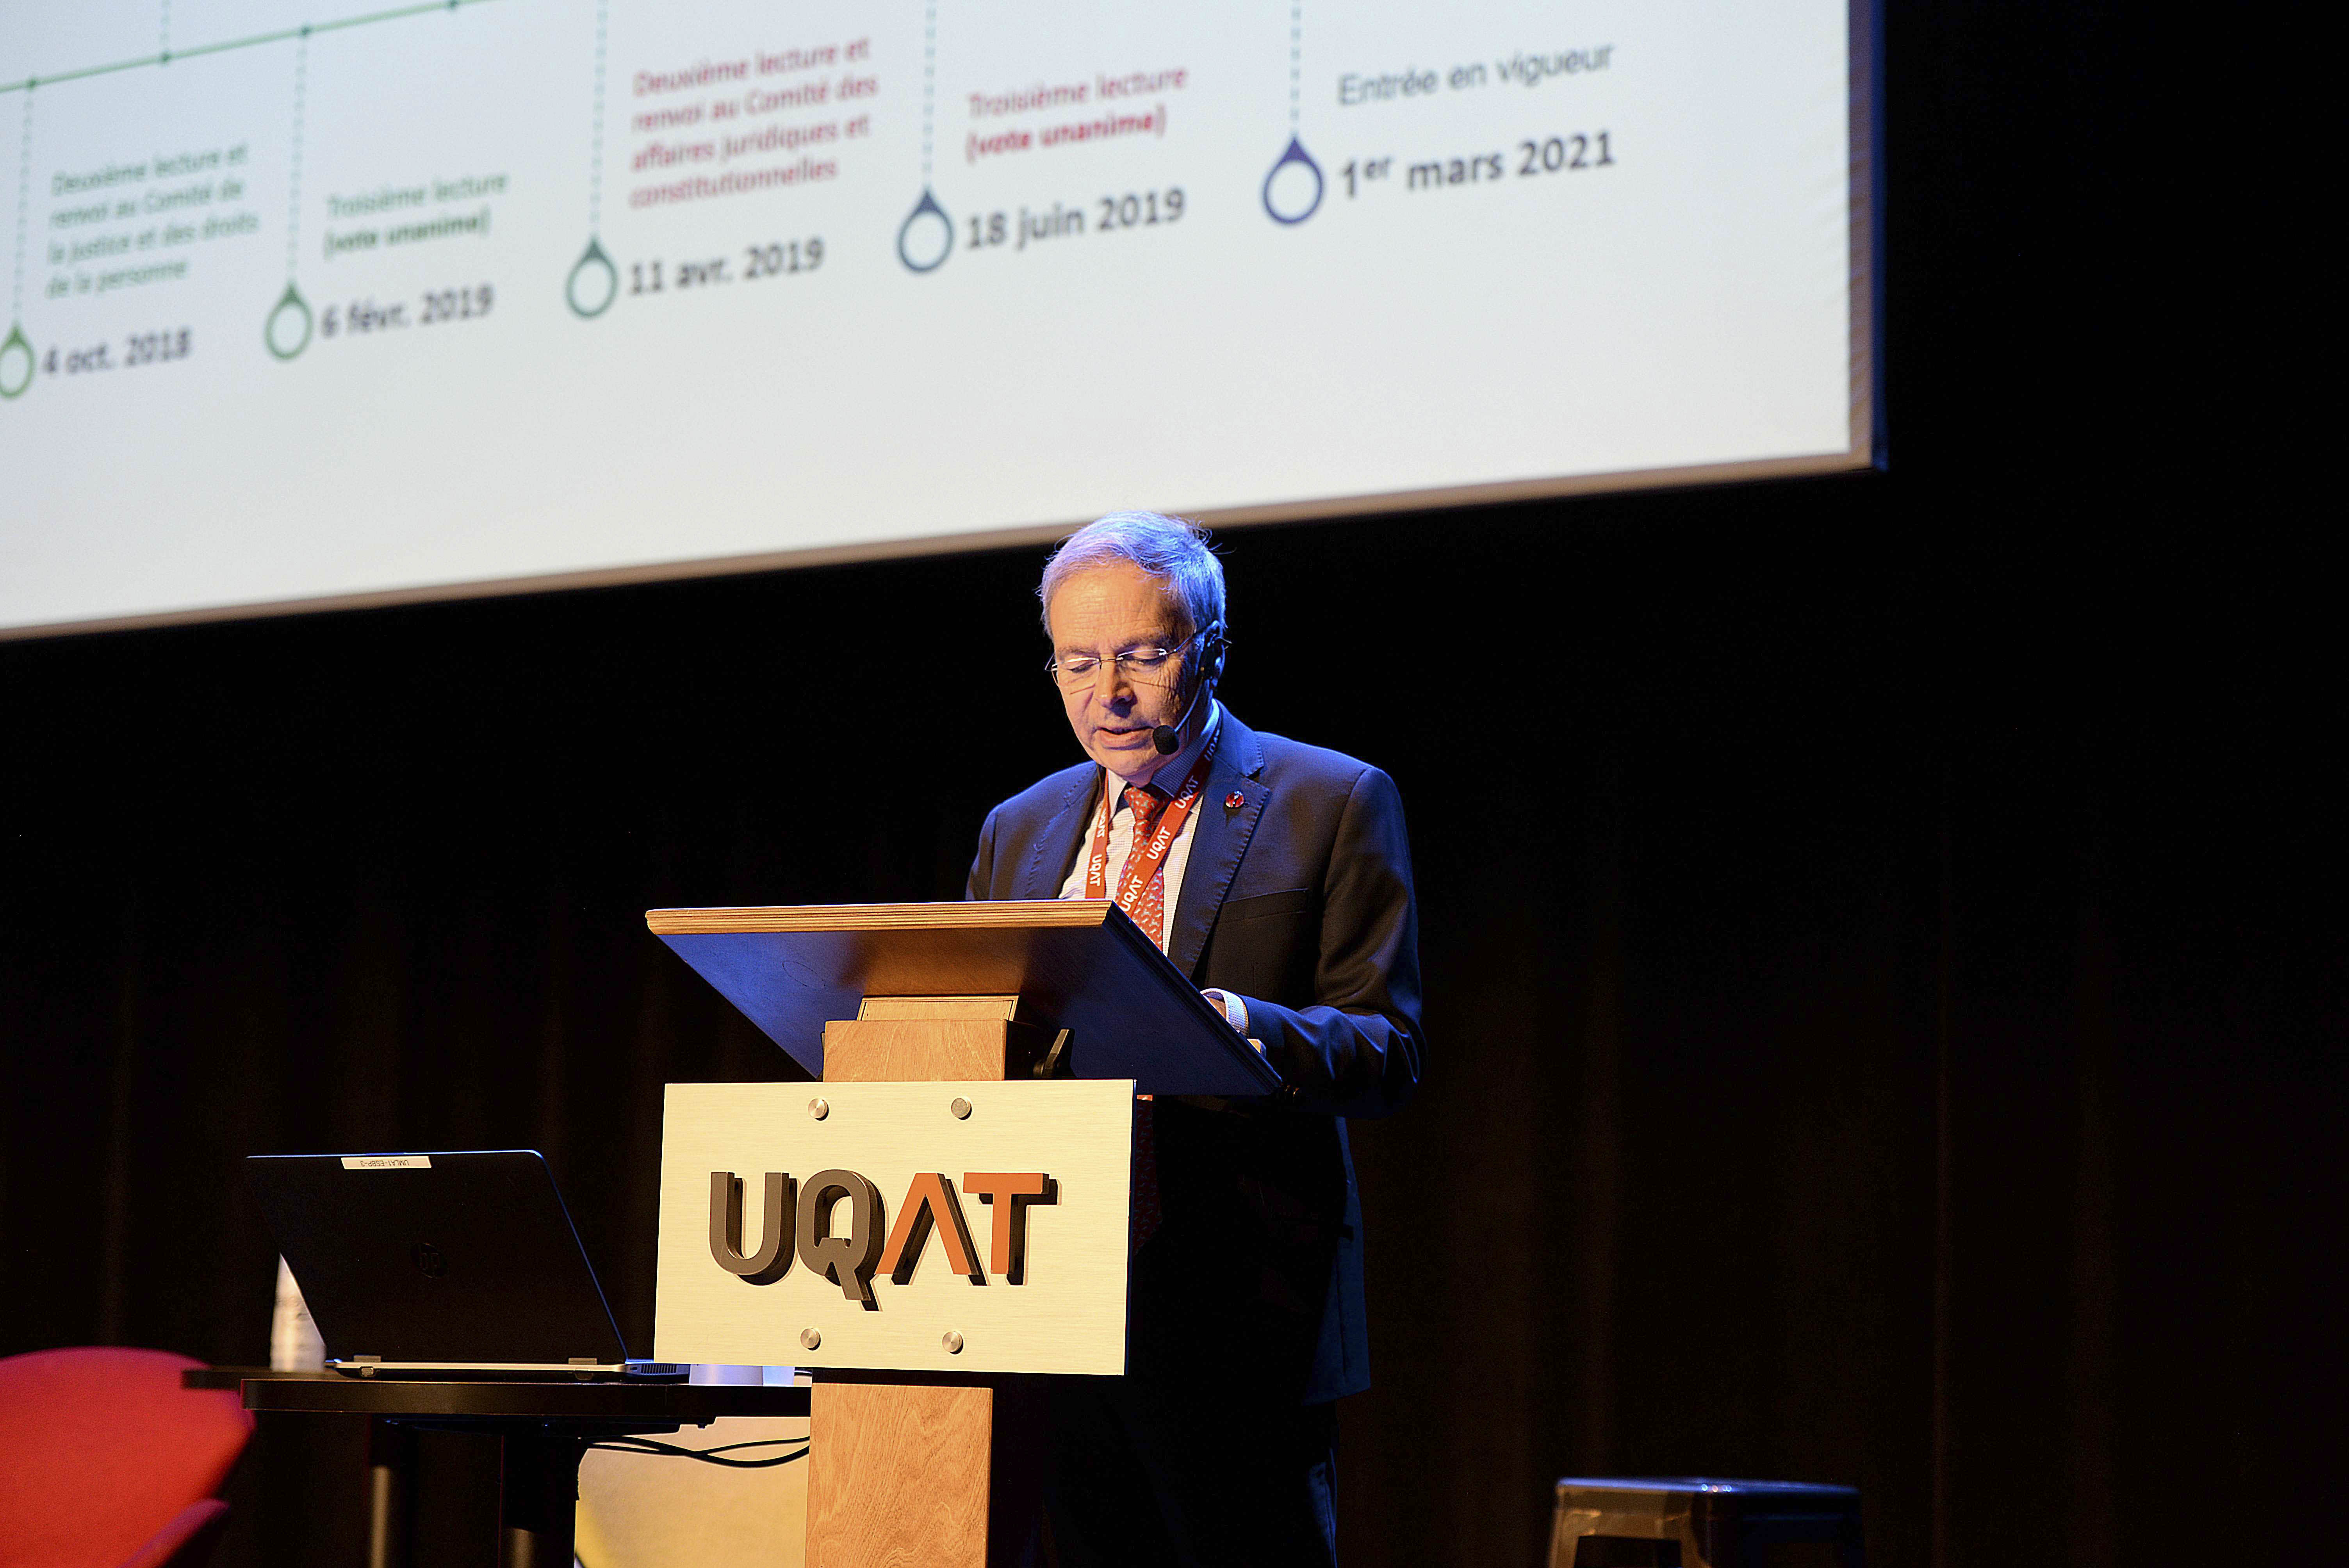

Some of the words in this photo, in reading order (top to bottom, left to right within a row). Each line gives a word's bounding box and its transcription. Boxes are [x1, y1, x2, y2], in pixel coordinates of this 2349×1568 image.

[634, 59, 748, 95] Deuxième
[757, 45, 837, 75] lecture
[845, 38, 870, 60] et
[970, 86, 1088, 117] Troisième
[1097, 68, 1187, 98] lecture
[1339, 66, 1439, 104] Entrée
[1448, 63, 1486, 88] en
[1497, 45, 1613, 85] vigueur
[633, 106, 702, 131] renvoi
[713, 101, 737, 119] au
[746, 83, 829, 112] Comité
[838, 76, 877, 99] des
[228, 144, 248, 165] et
[633, 141, 714, 170] affaires
[723, 120, 837, 162] juridiques
[846, 114, 870, 137] et
[968, 132, 1030, 164] (vote
[1042, 104, 1165, 146] unanime)
[630, 159, 836, 207] constitutionnelles
[1408, 154, 1503, 189] mars
[1520, 132, 1615, 175] 2021
[435, 175, 507, 201] lecture
[970, 211, 1006, 247] 18
[1017, 203, 1083, 250] juin
[1100, 188, 1185, 230] 2019
[630, 263, 662, 294] 11
[676, 259, 732, 287] avr.
[745, 237, 824, 279] 2019
[323, 306, 337, 337] 6
[421, 285, 492, 323] 2019
[44, 347, 58, 374] 4
[67, 344, 113, 373] oct.
[126, 328, 190, 366] 2018
[1175, 775, 1199, 809] UQAT
[1147, 826, 1171, 860] UQAT
[1089, 854, 1102, 886] UQAT
[1119, 876, 1144, 912] UQAT
[709, 1169, 1058, 1311] UQAT
